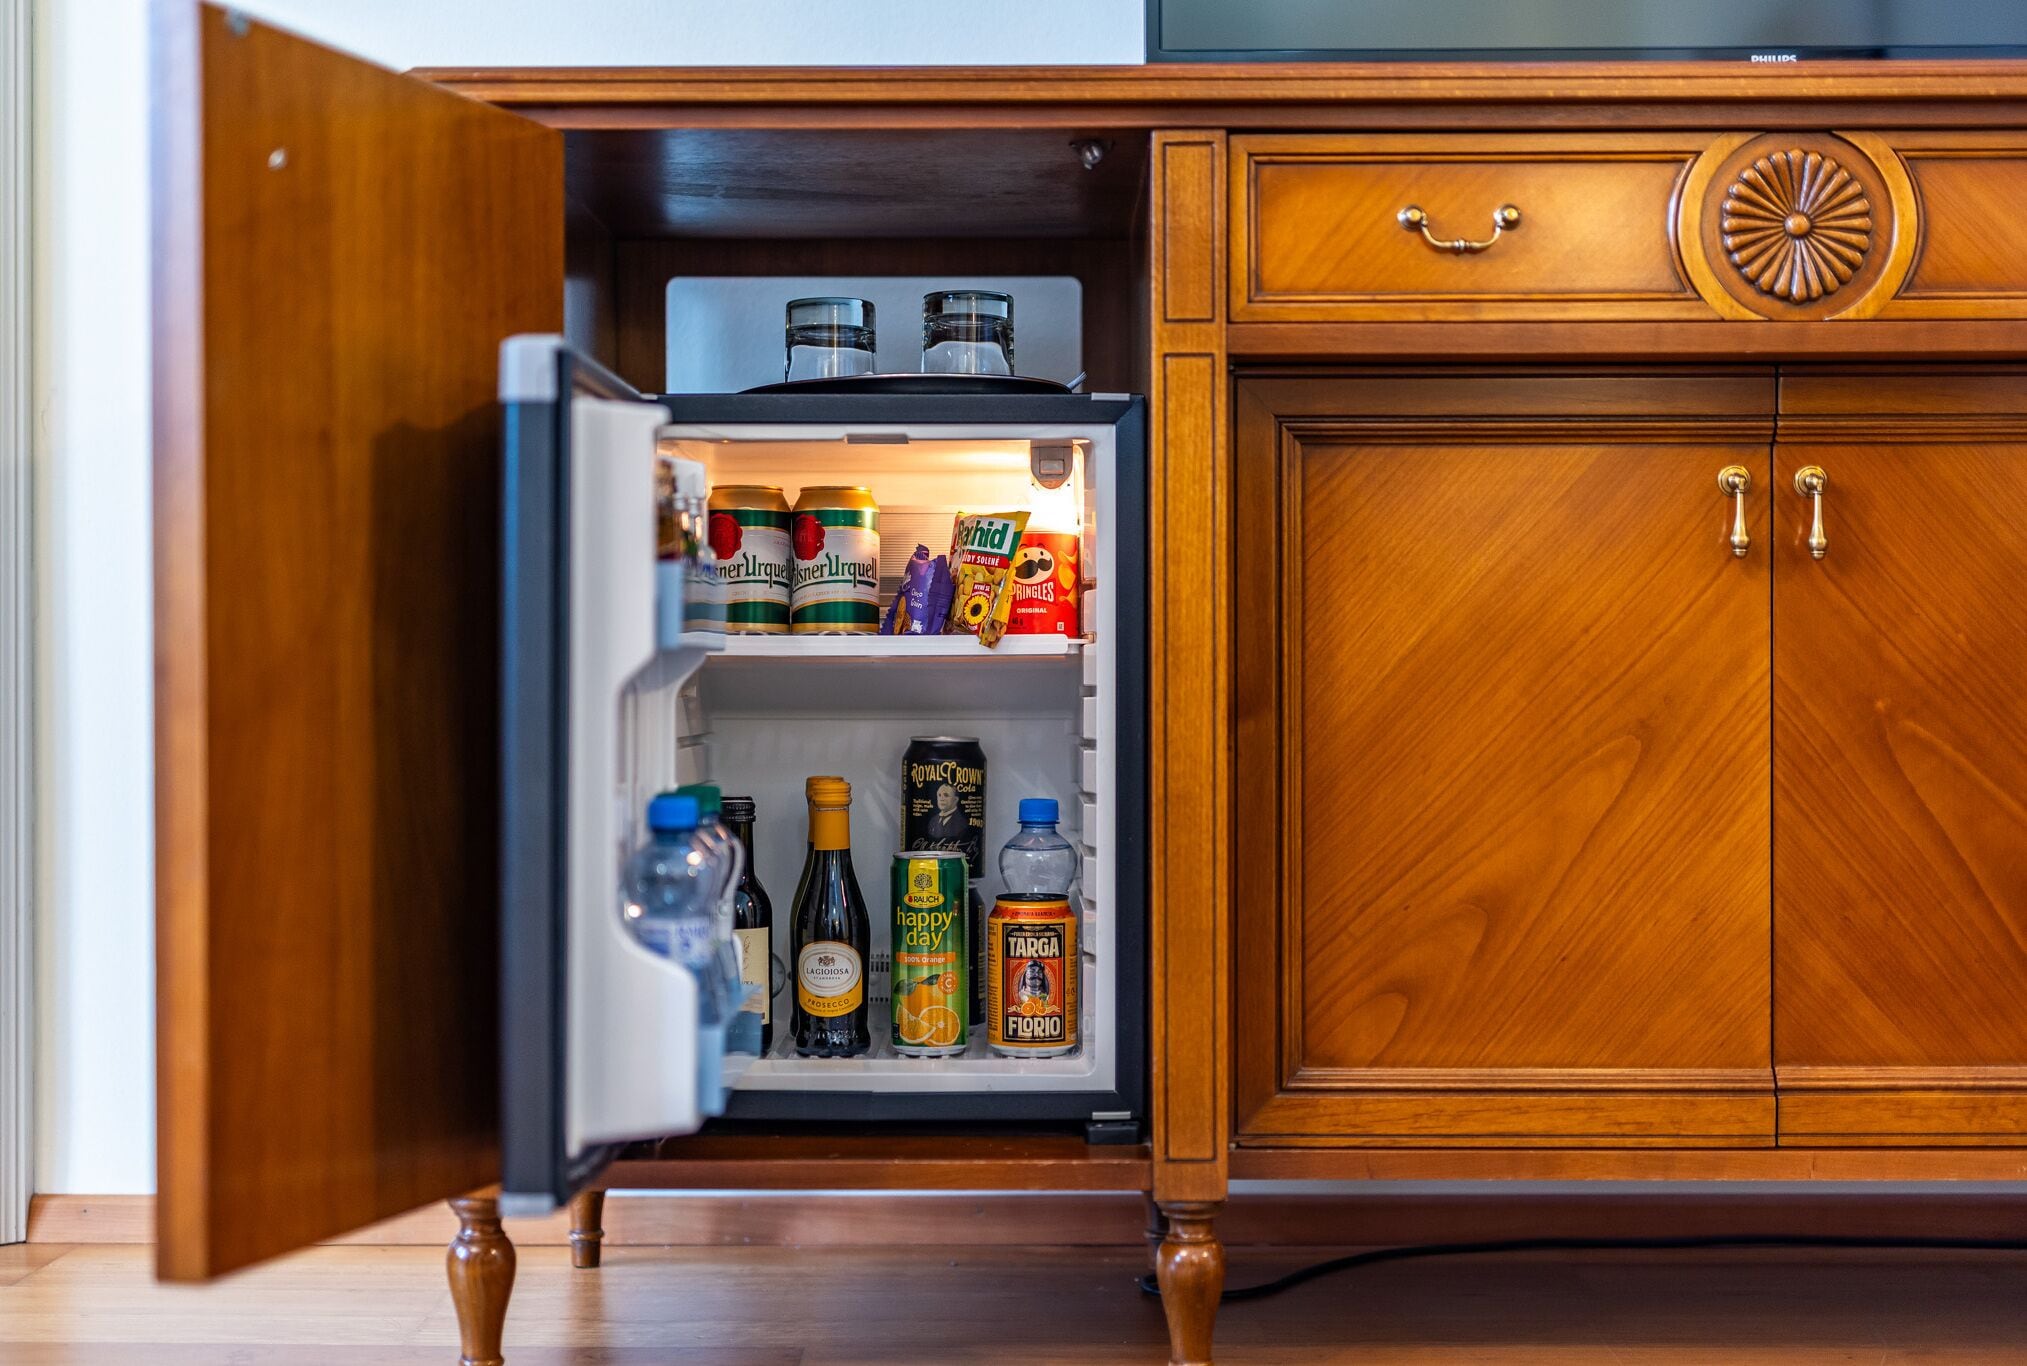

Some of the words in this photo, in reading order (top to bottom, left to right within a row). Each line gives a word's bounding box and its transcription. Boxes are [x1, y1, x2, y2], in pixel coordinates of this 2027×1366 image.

[1750, 54, 1798, 63] PHILIPS
[825, 551, 878, 588] Urquell
[911, 763, 943, 788] ROYAL
[940, 761, 982, 786] CROWN
[957, 784, 976, 793] Cola
[913, 895, 940, 903] RAUCH
[896, 905, 953, 932] happy
[906, 926, 942, 951] day
[1008, 937, 1060, 958] TARGA
[921, 956, 946, 964] Orange
[807, 998, 850, 1009] PROSECCO
[1008, 1016, 1061, 1038] FLORIO
